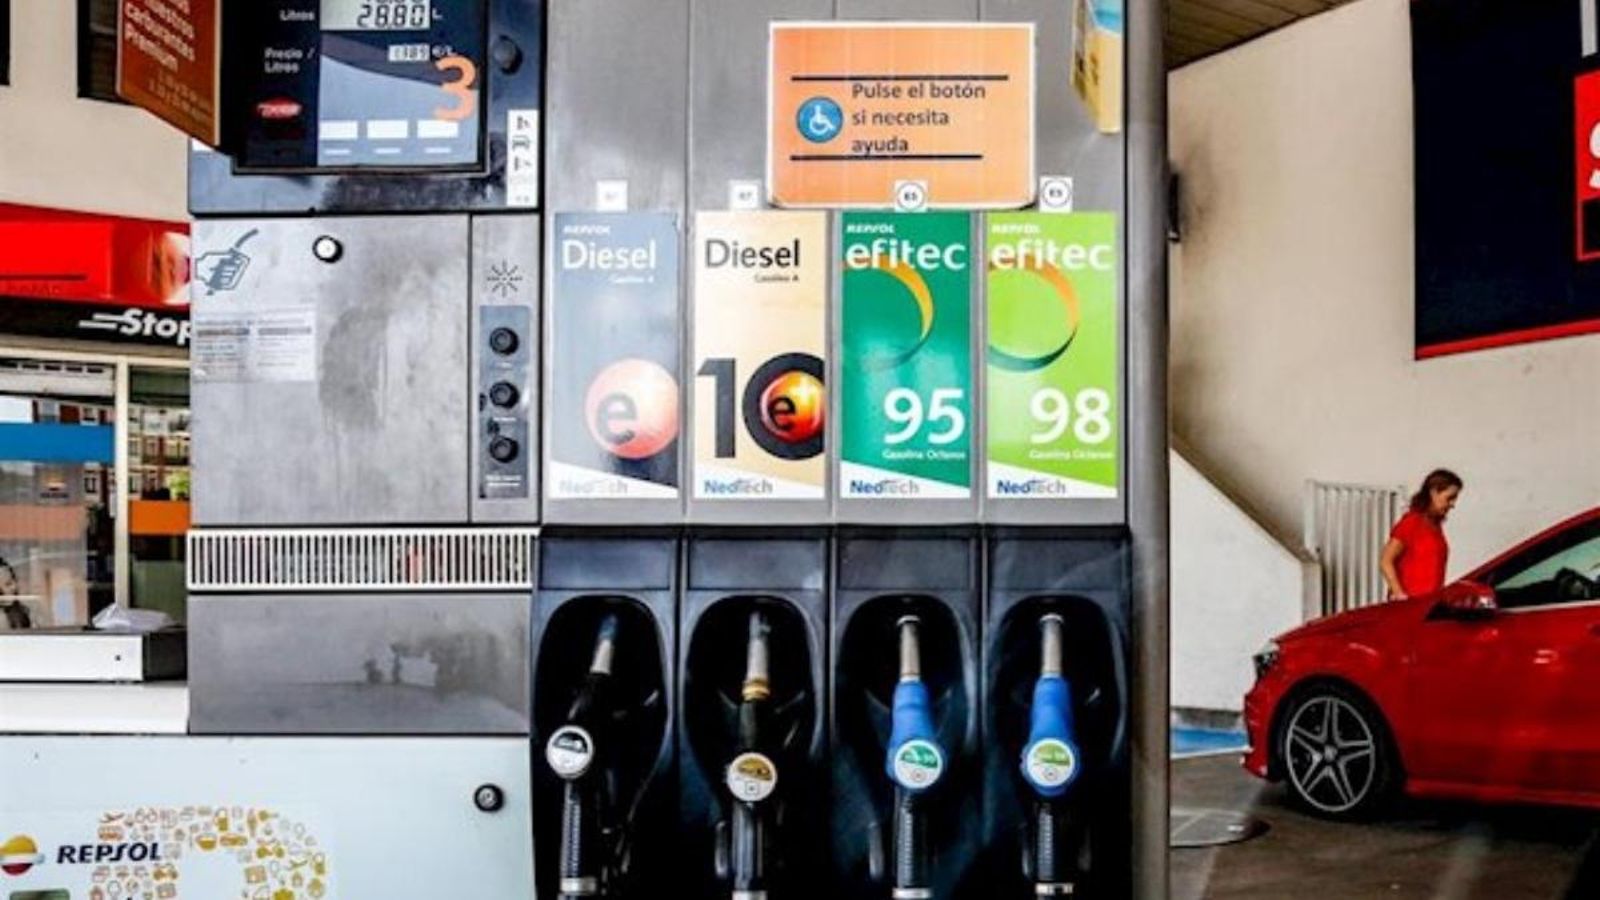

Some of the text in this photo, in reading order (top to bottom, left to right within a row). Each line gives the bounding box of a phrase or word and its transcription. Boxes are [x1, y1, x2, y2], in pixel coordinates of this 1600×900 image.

[280, 10, 315, 21] Litros
[265, 47, 302, 58] Precio
[265, 61, 298, 73] Litros
[434, 56, 476, 121] 3
[852, 82, 986, 99] Pulse el botón
[852, 110, 949, 126] si necesita
[852, 138, 909, 154] ayuda
[562, 239, 656, 270] Diesel
[705, 238, 800, 269] Diesel
[846, 237, 967, 271] efitec
[990, 237, 1113, 271] efitec
[118, 307, 191, 346] Stop
[883, 387, 967, 445] 95
[1028, 387, 1112, 445] 98
[703, 478, 774, 495] NeoTech
[849, 479, 920, 495] NeoTech
[996, 479, 1067, 495] NeoTech
[56, 842, 162, 864] REPSOL
